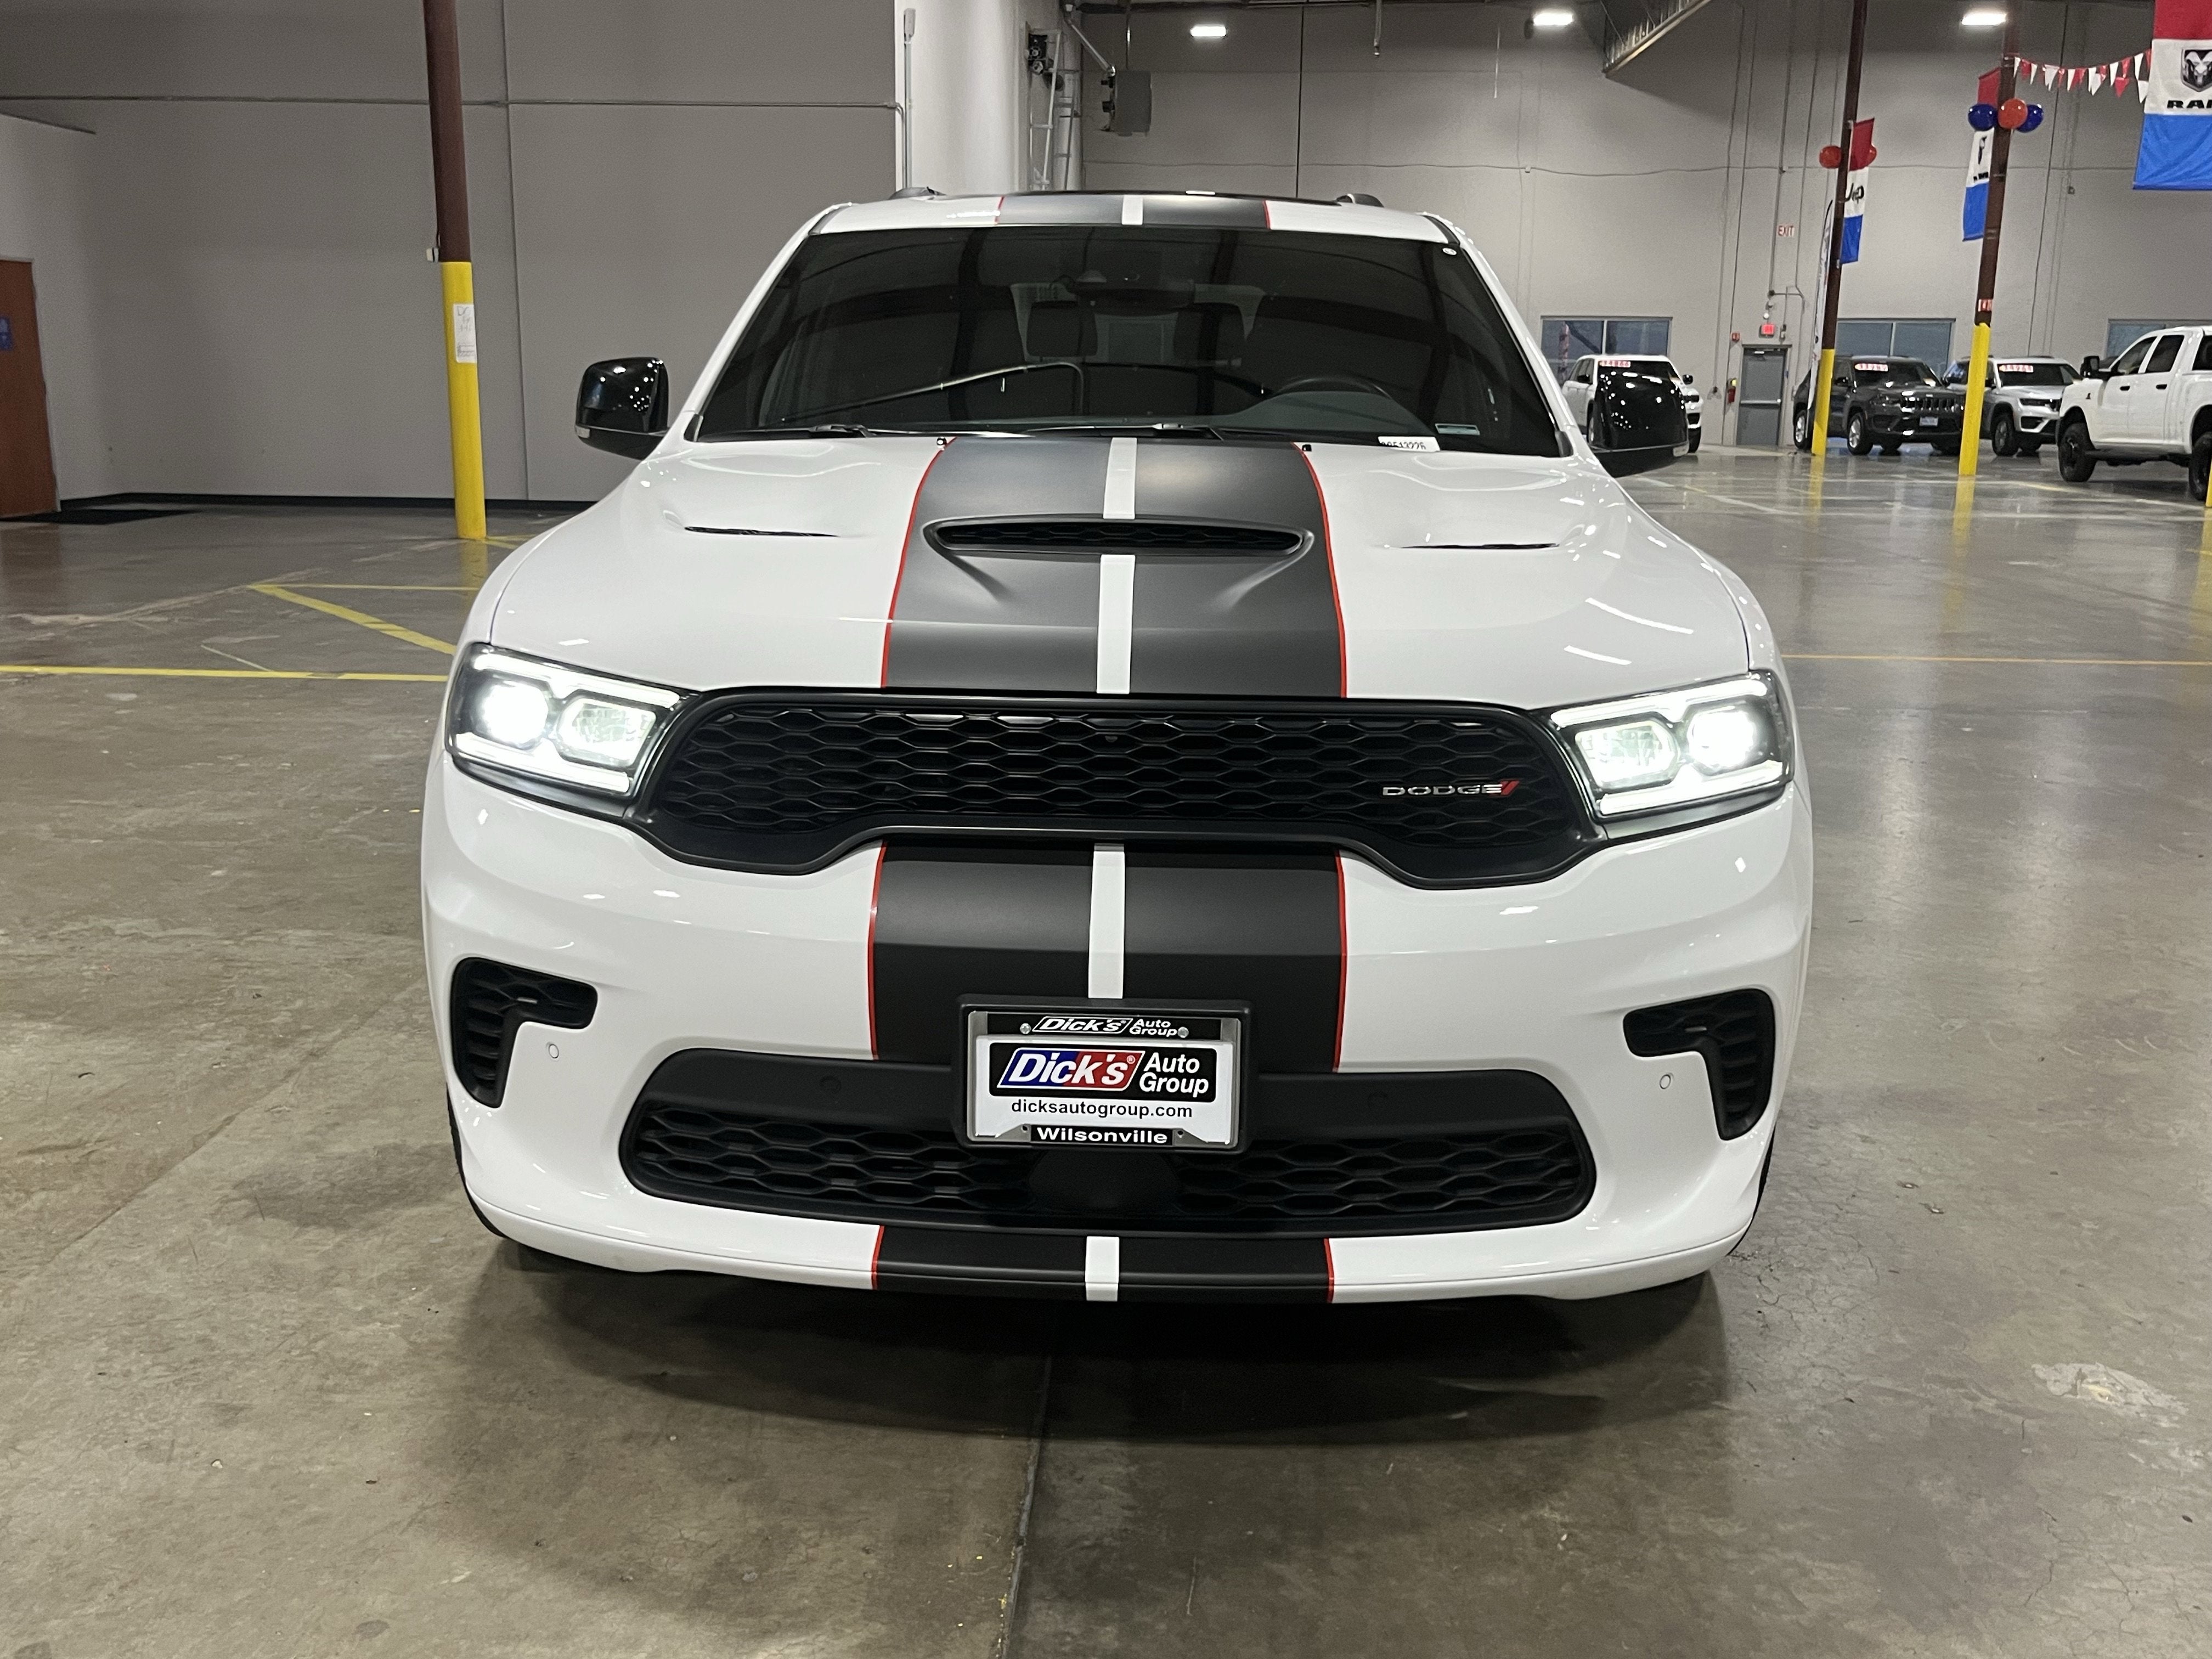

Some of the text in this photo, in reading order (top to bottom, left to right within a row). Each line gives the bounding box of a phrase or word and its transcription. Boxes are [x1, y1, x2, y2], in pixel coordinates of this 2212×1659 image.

[1778, 225, 1793, 236] EXIT
[1383, 785, 1503, 795] DODGE
[1039, 1018, 1171, 1031] Dick's Auto
[1129, 1026, 1178, 1037] Group
[1008, 1052, 1200, 1085] Dick's Auto
[1139, 1072, 1209, 1098] Group
[1011, 1099, 1193, 1119] dicksautogroup.com
[1036, 1127, 1168, 1144] Wilsonville
